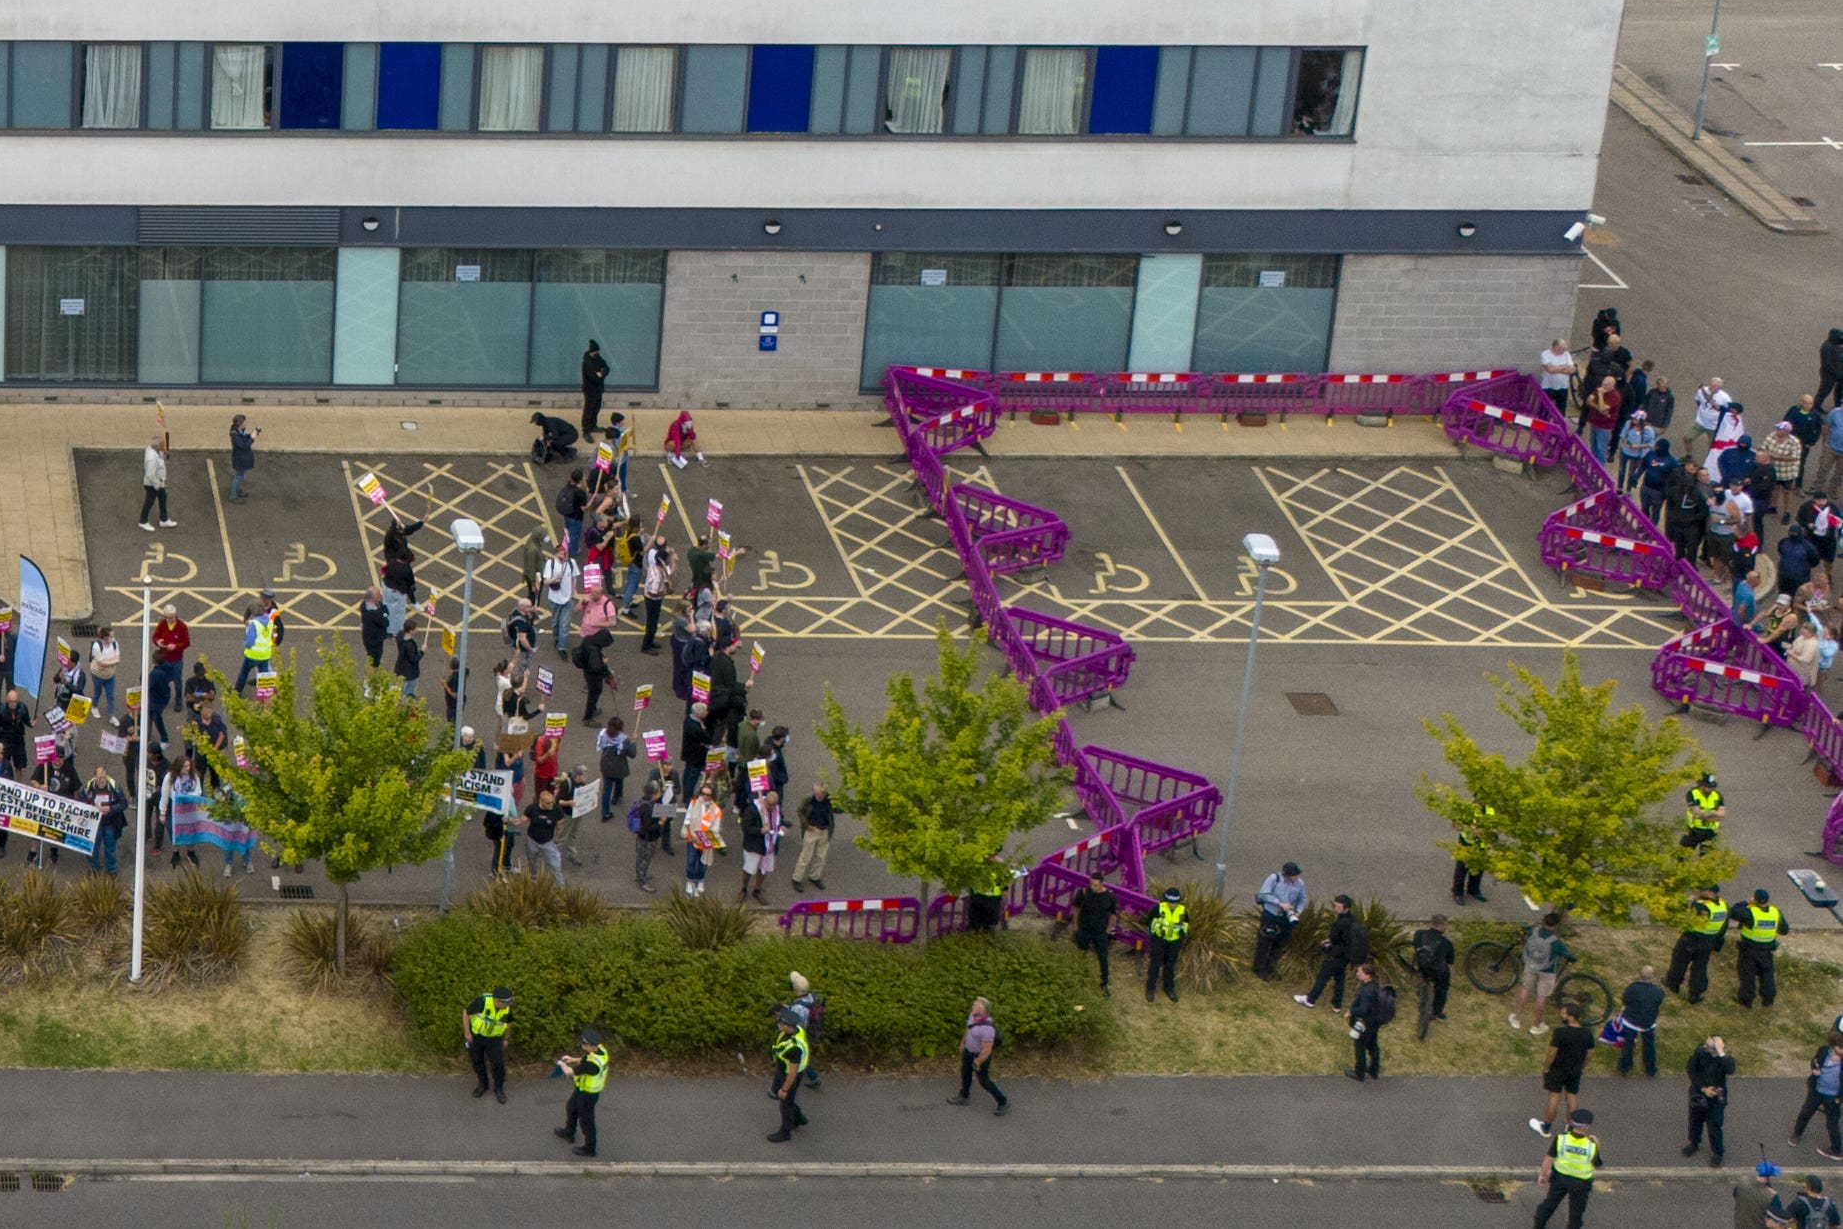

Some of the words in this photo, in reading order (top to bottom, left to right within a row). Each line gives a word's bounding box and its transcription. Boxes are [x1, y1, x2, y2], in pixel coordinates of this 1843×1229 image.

[470, 770, 505, 786] STAND
[24, 791, 40, 803] UP
[43, 797, 56, 809] TO
[58, 802, 99, 821] RACISM
[25, 811, 91, 838] DERBYSHIRE
[64, 814, 72, 822] &
